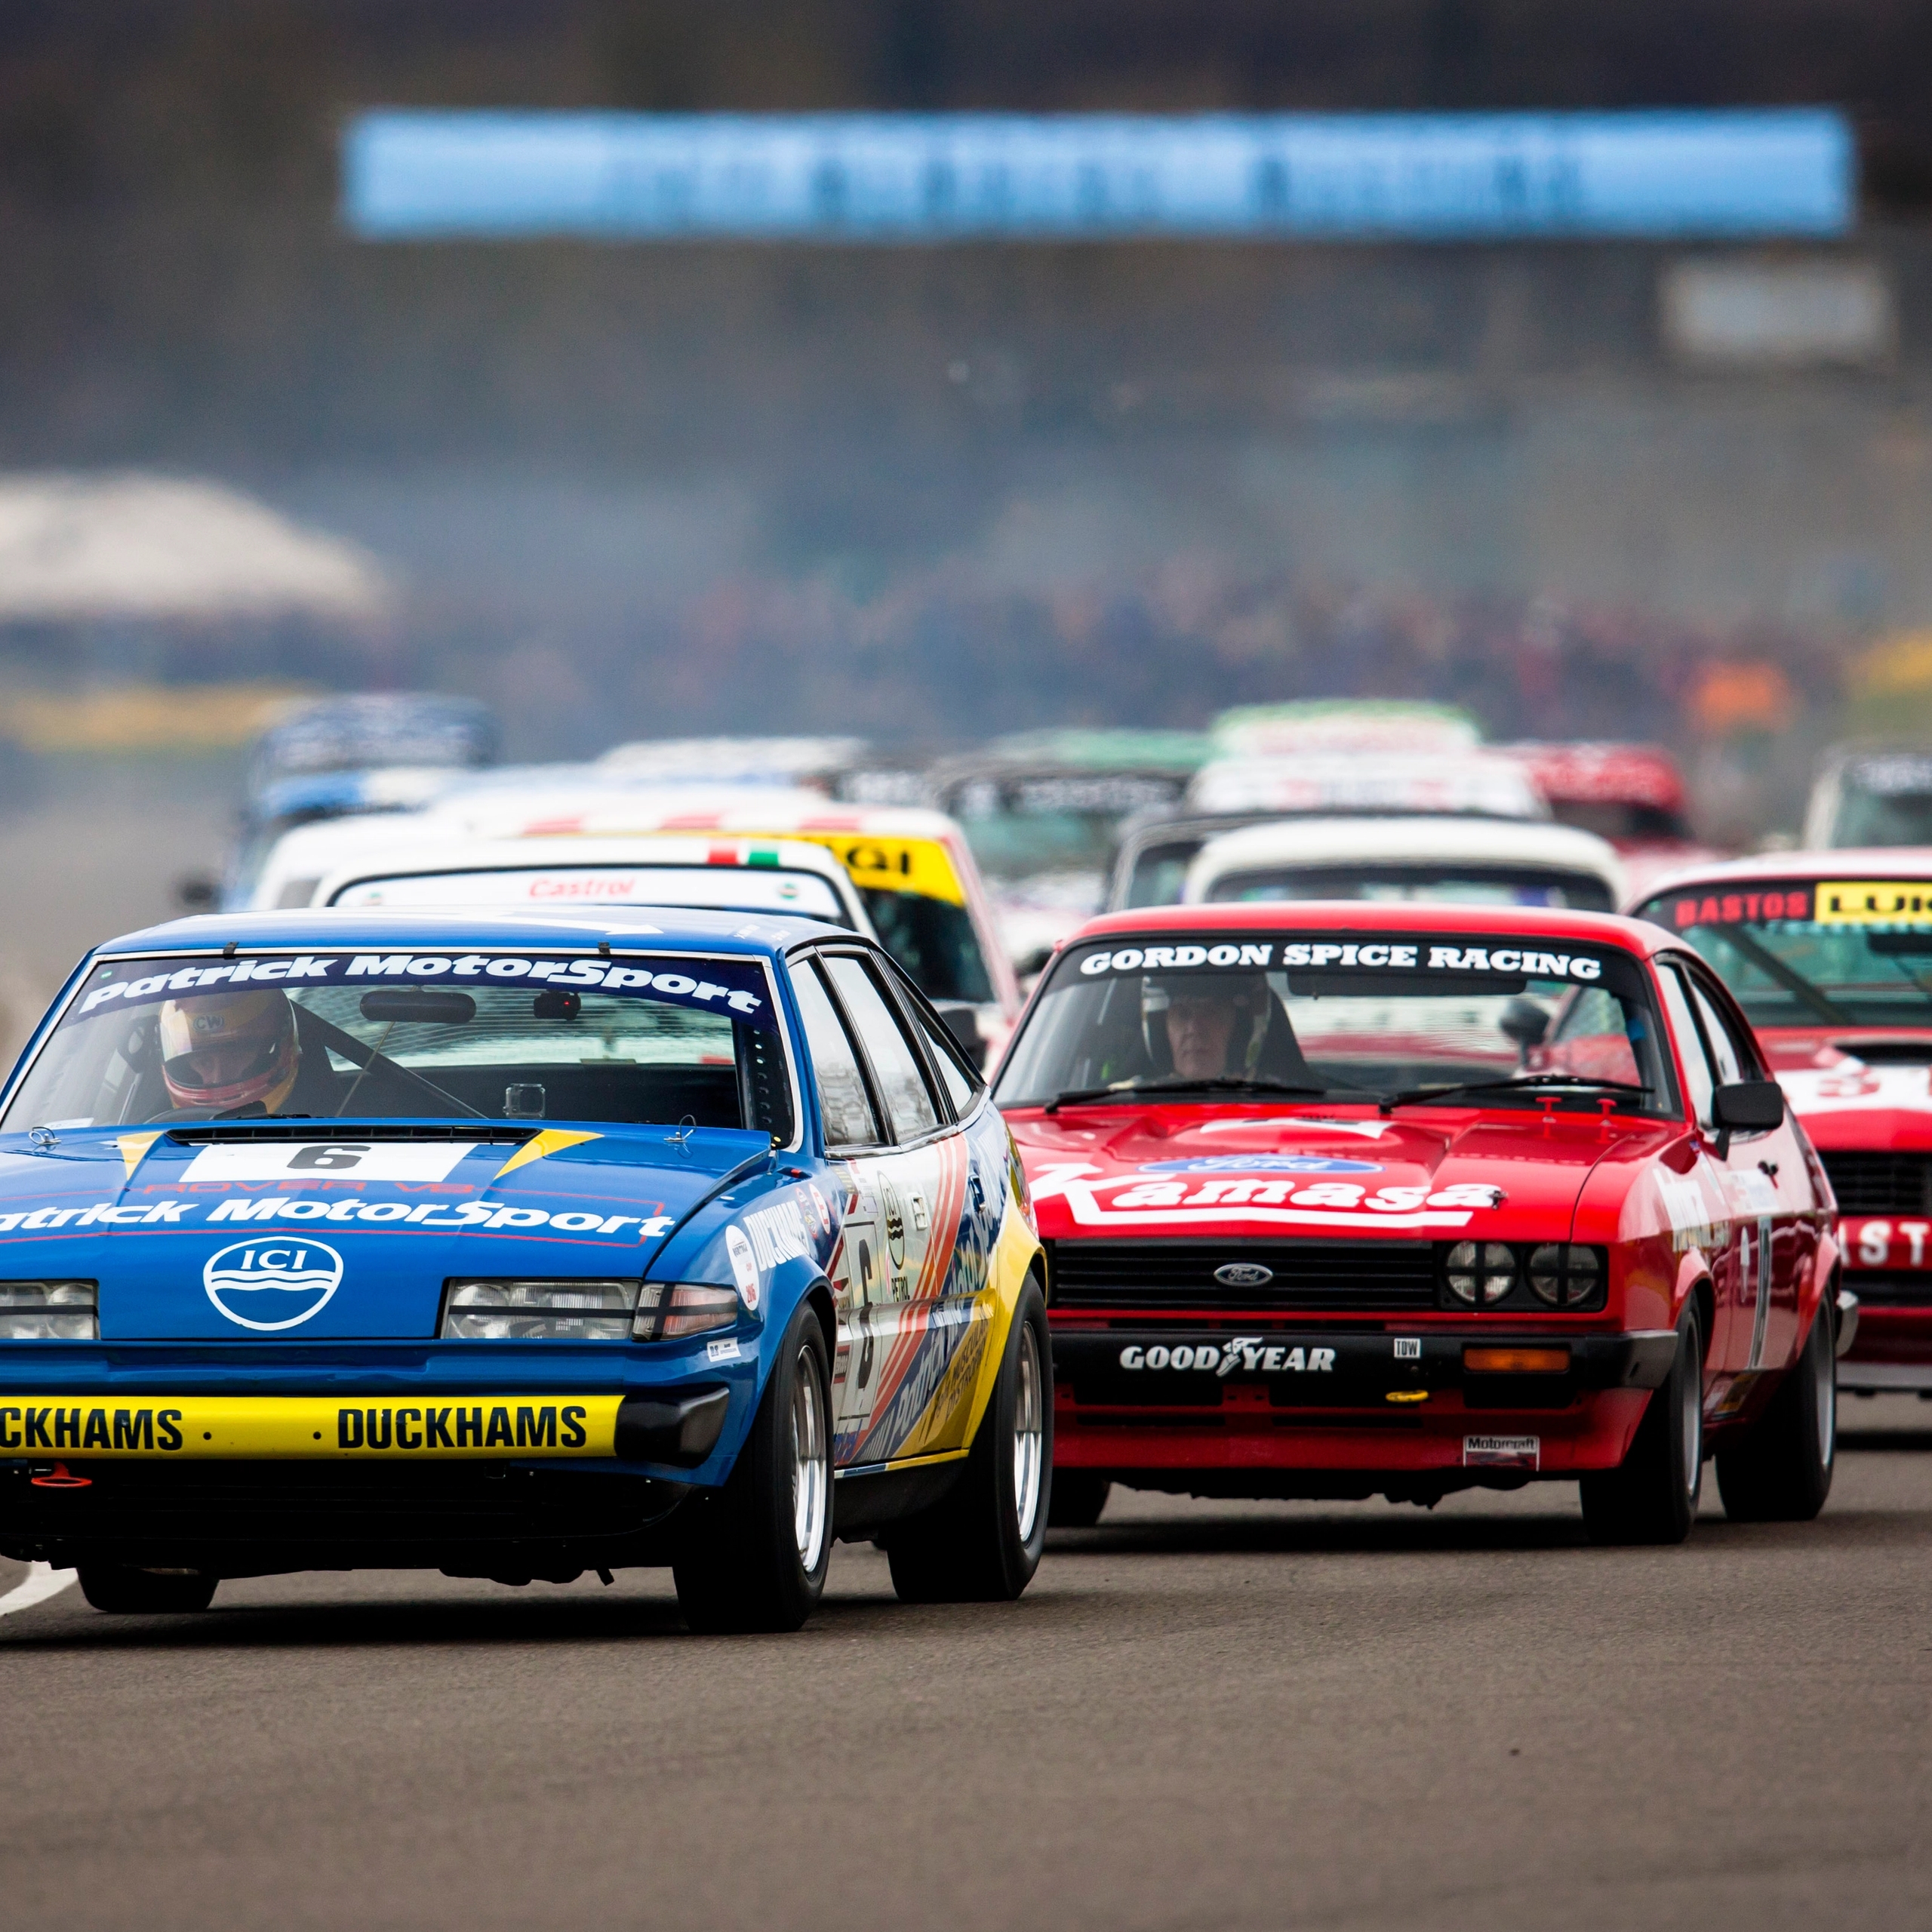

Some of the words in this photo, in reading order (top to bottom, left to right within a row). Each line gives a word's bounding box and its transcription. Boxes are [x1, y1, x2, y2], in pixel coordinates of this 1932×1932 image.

[1675, 892, 1809, 928] BASTOS
[1080, 944, 1273, 975] GORDON
[1283, 944, 1419, 968] SPICE
[1429, 945, 1601, 980] RACING
[287, 1144, 372, 1170] 6
[1188, 1152, 1333, 1172] Ford
[142, 1180, 368, 1195] ROVER
[1031, 1162, 1502, 1228] Kamasa
[240, 1249, 305, 1271] ICI
[1228, 1266, 1260, 1281] Ford
[1396, 1341, 1418, 1355] TOW
[337, 1406, 587, 1450] DUCKHAMS
[1468, 1436, 1535, 1449] Motorcraft
